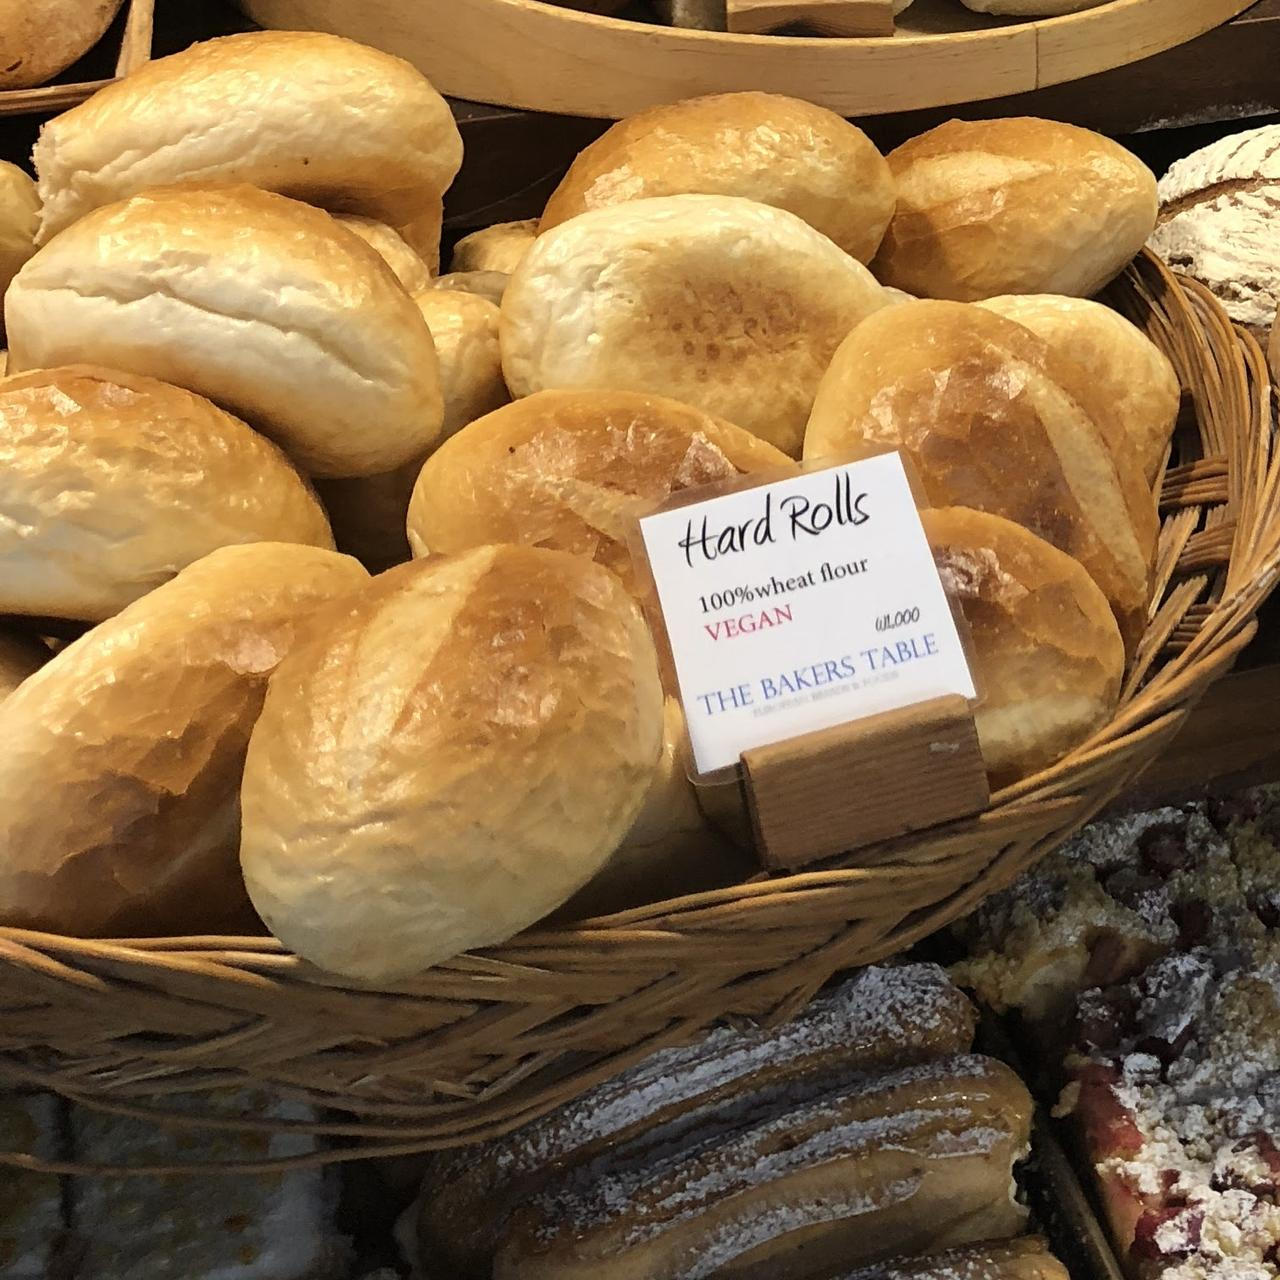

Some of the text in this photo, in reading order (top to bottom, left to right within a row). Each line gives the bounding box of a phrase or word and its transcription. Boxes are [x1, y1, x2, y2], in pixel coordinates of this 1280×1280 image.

[678, 471, 870, 568] Hard Rolls
[820, 557, 869, 584] flour
[703, 604, 794, 642] VEGAN
[696, 683, 755, 716] THE
[759, 655, 857, 701] BAKERS
[859, 632, 940, 671] TABLE
